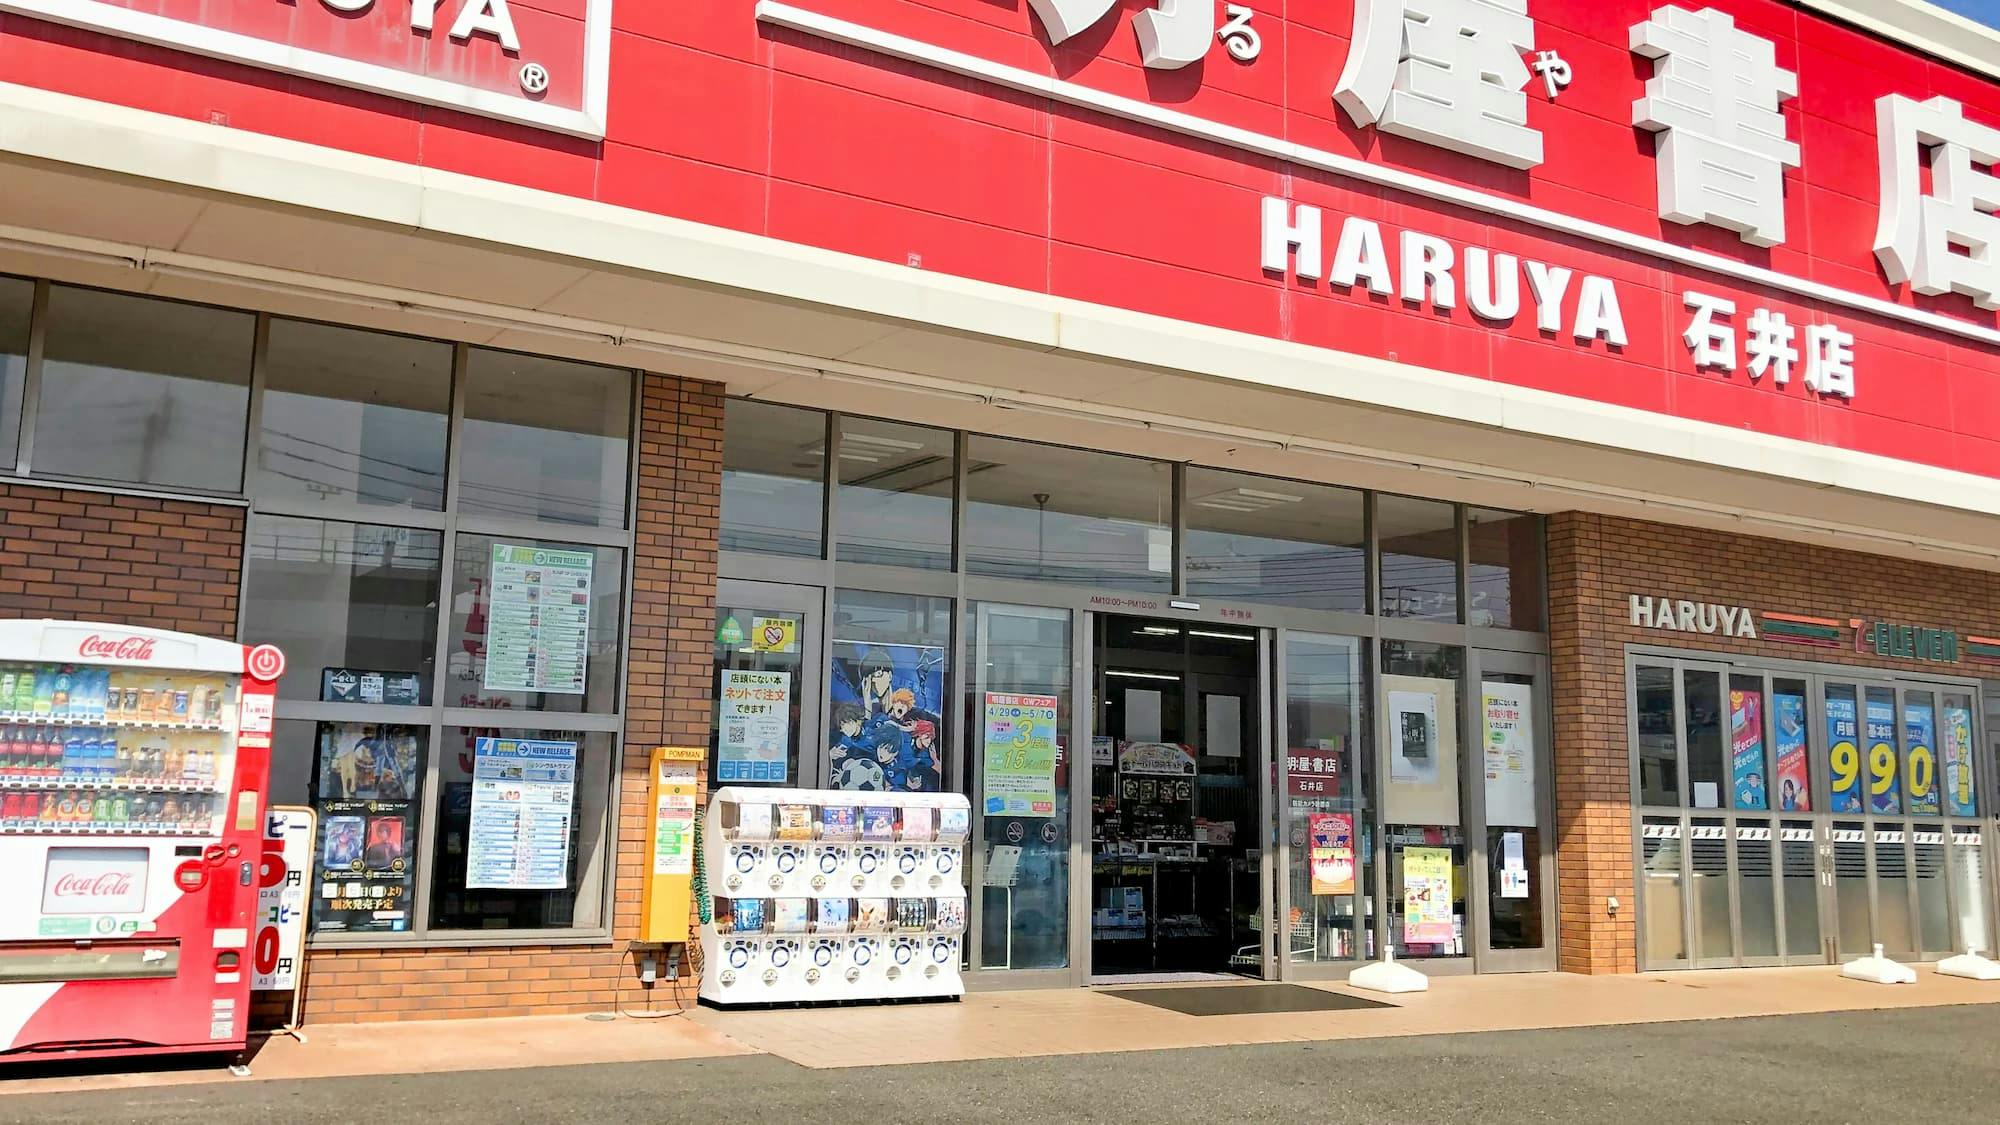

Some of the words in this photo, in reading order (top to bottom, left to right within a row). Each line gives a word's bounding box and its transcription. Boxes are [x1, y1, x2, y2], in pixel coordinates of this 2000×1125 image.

[1532, 50, 1573, 100] や
[1260, 196, 1629, 346] HARUYA
[1682, 290, 1856, 398] 石井店
[1220, 608, 1253, 620] 年中無休
[1629, 594, 1757, 639] HARUYA
[731, 673, 782, 685] 店頭にない本
[725, 687, 785, 701] ネットで注文
[1488, 709, 1519, 720] お取り寄せ
[532, 746, 546, 755] NEW
[546, 747, 571, 756] RELEASE
[1299, 780, 1324, 791] 石井店
[330, 898, 394, 910] 順次発売予定
